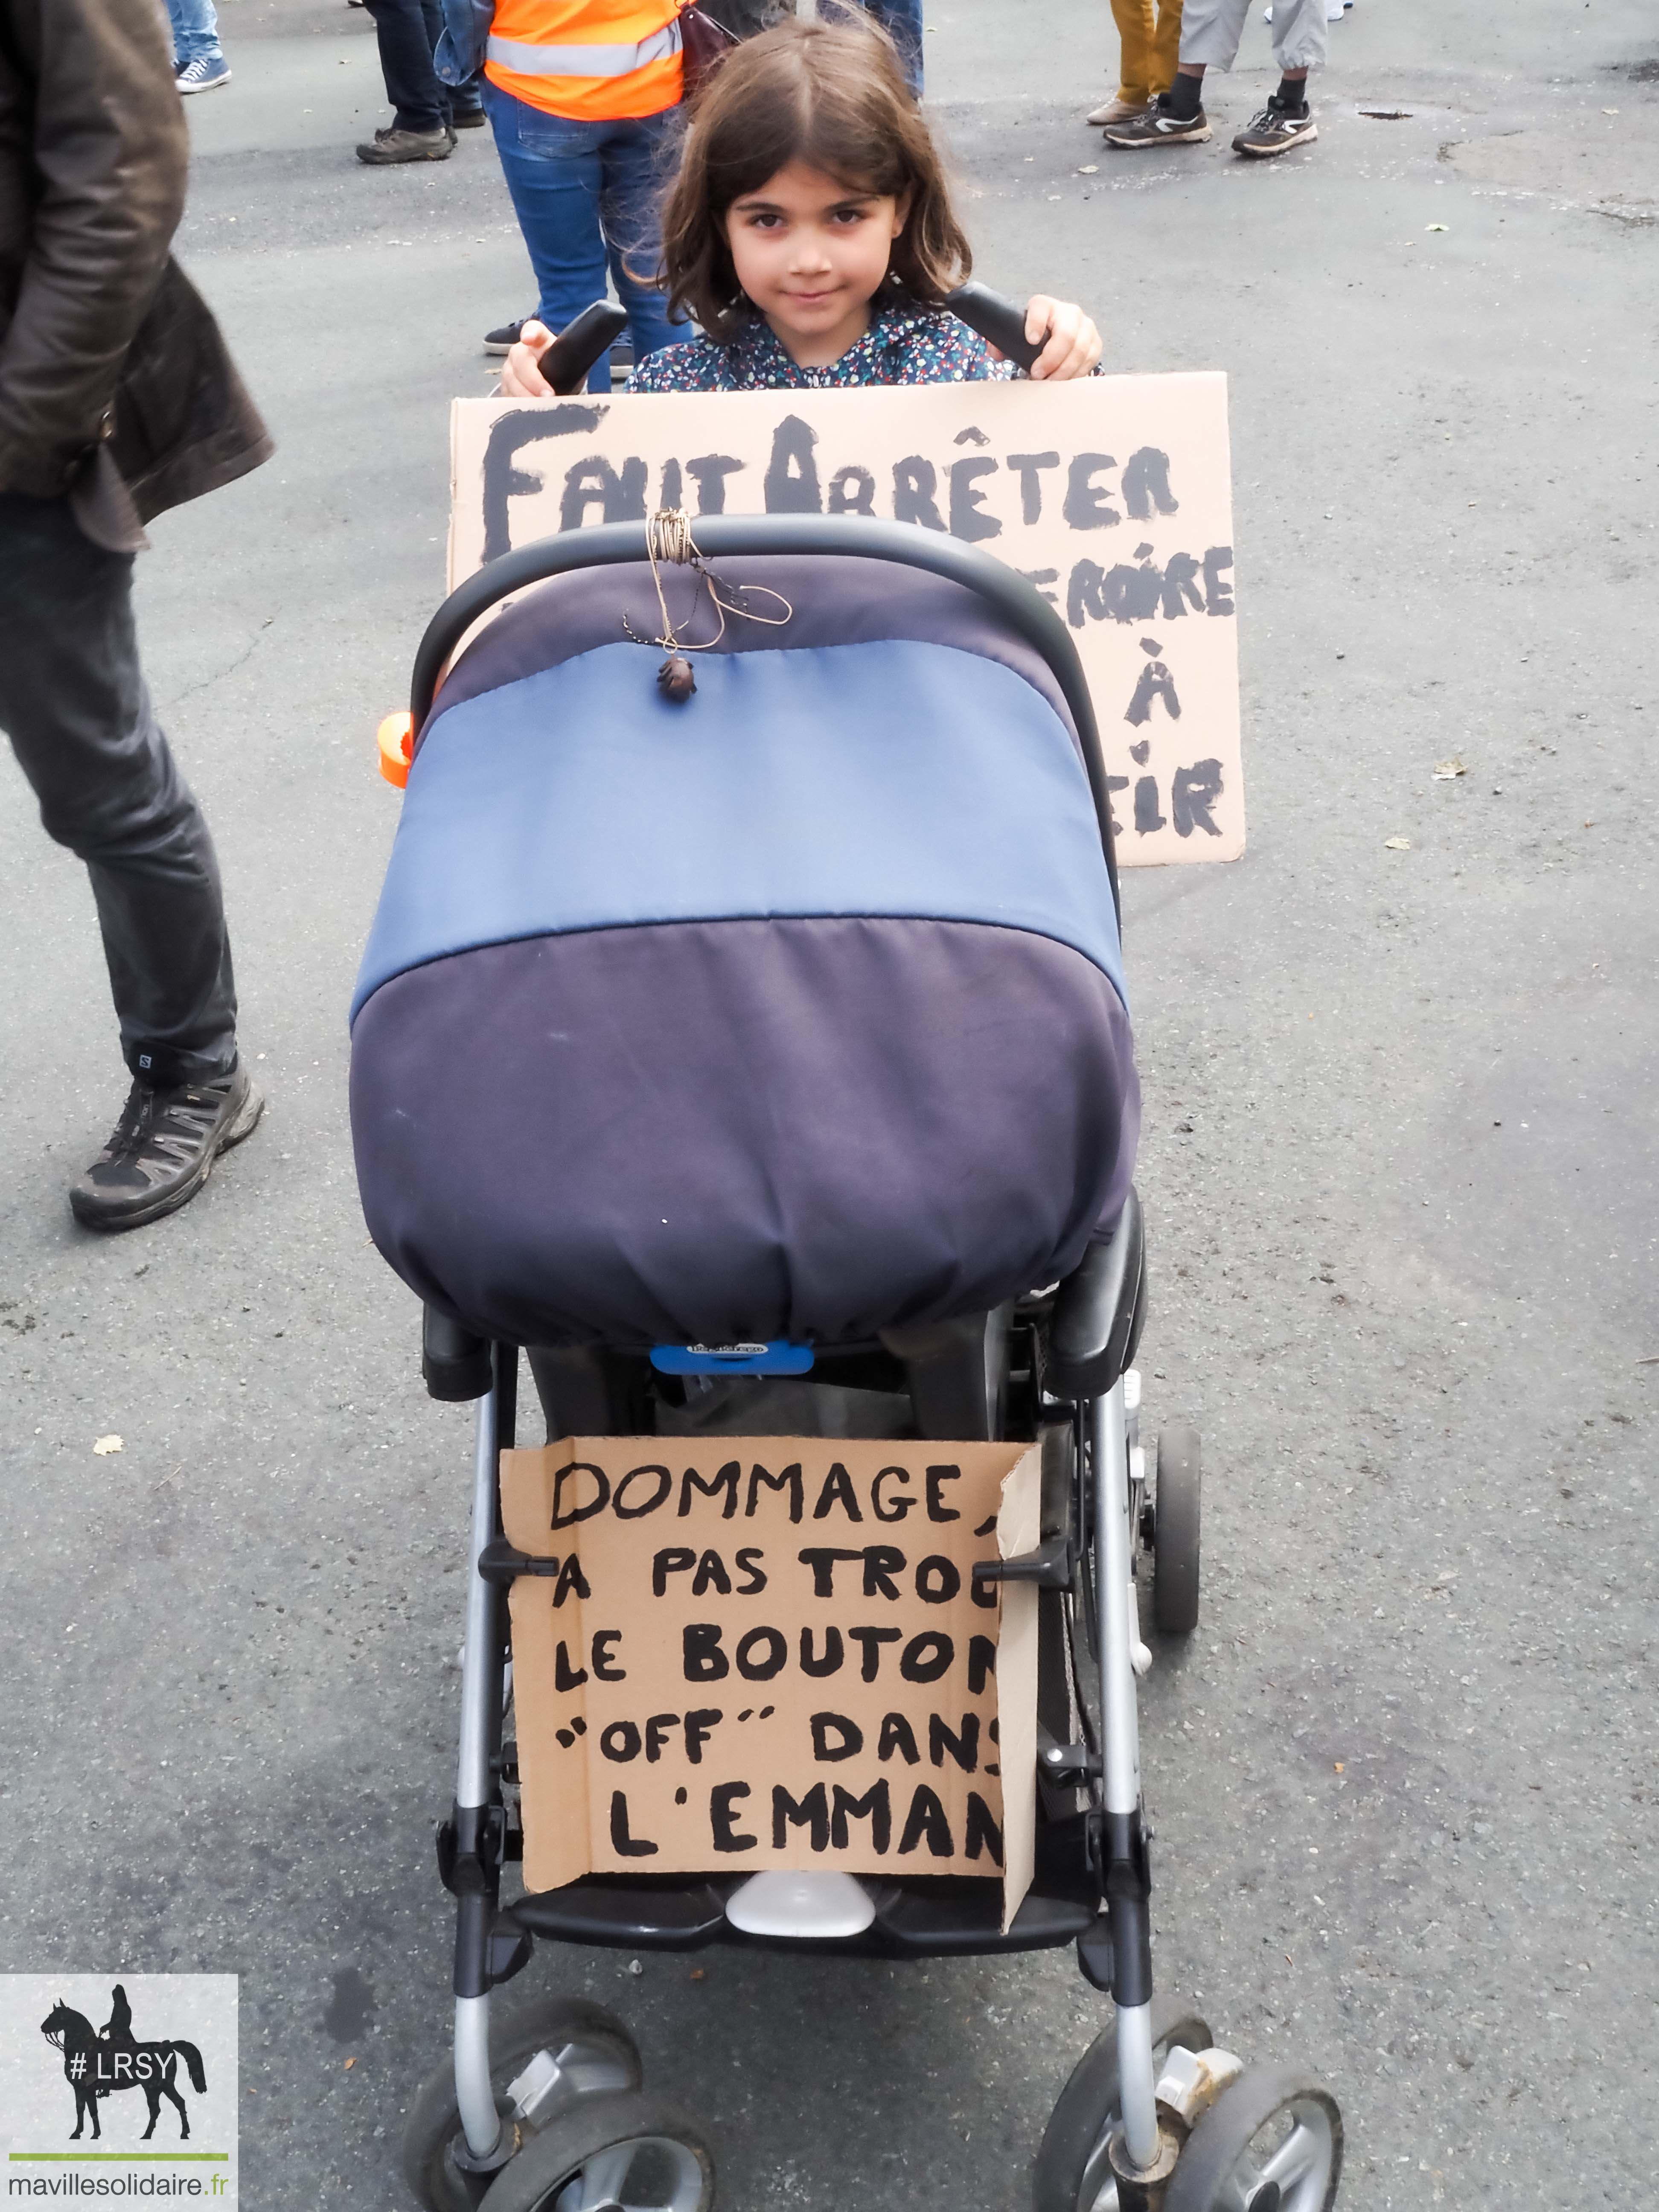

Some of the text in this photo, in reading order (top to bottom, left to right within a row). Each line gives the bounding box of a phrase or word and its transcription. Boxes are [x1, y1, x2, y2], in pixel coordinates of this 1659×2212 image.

[1124, 637, 1181, 727] À
[551, 1461, 997, 1537] DOMMAGE,
[653, 1546, 767, 1597] PAS
[556, 1630, 626, 1692] LE
